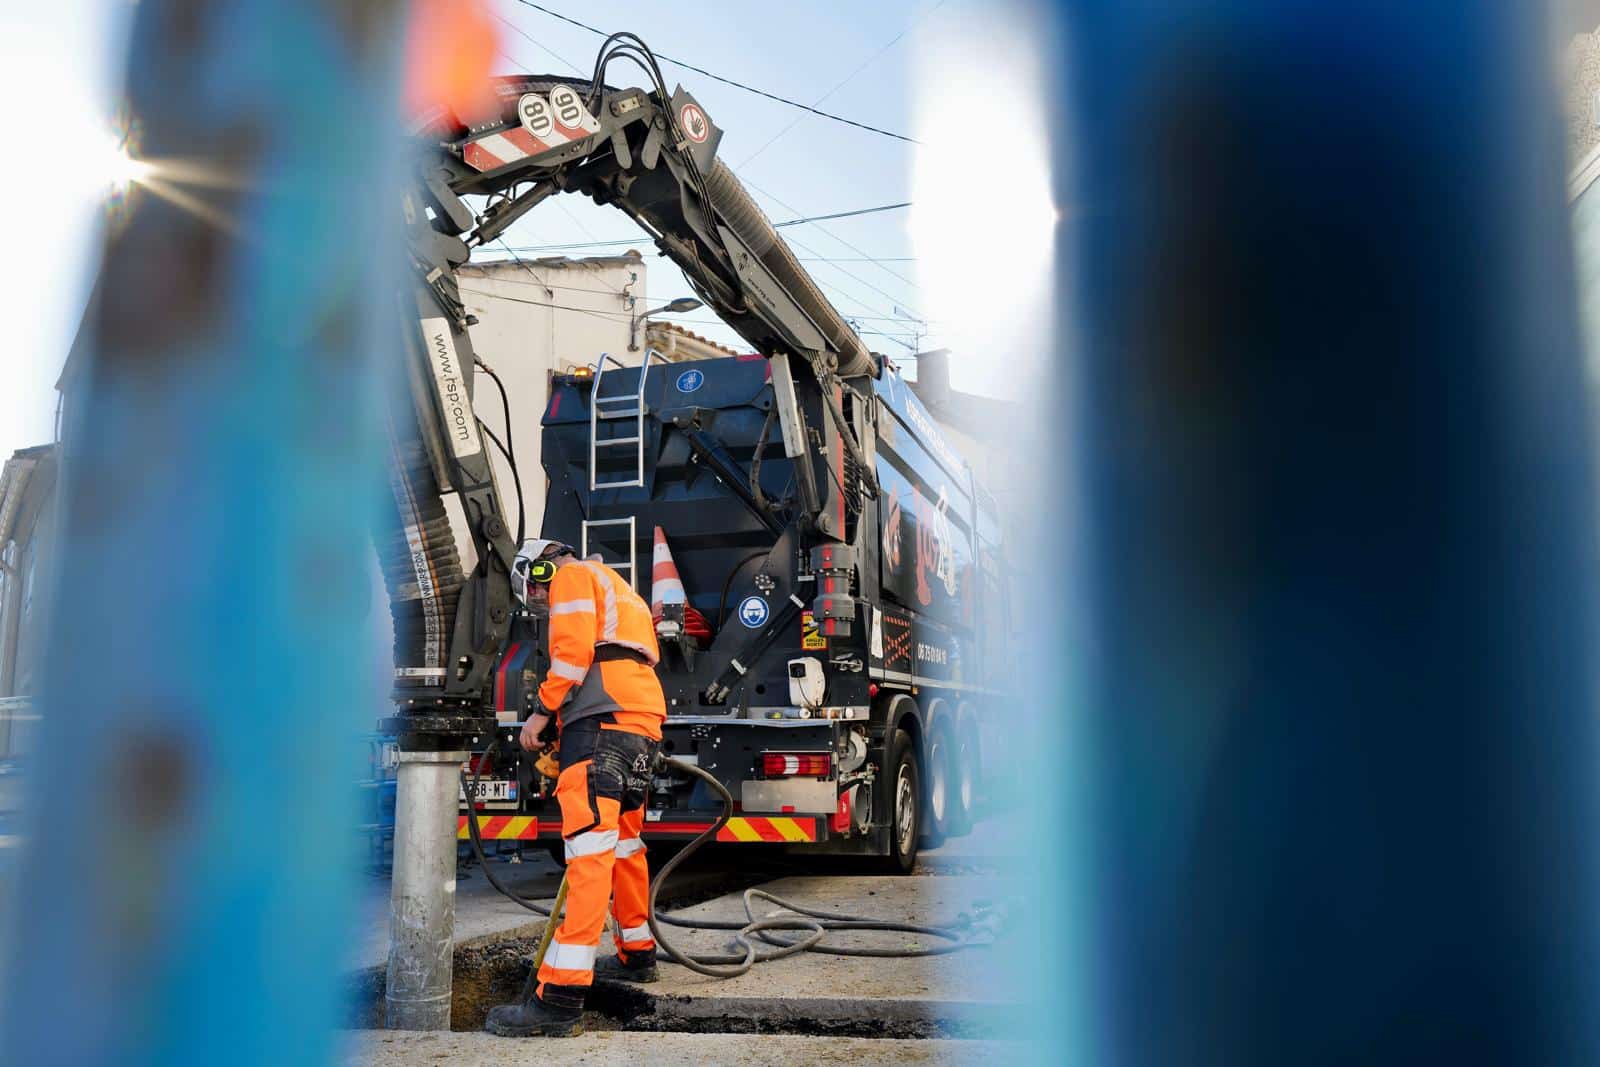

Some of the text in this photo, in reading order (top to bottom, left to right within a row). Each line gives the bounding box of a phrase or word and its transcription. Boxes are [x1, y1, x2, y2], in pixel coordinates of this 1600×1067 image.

[524, 102, 550, 130] 80
[555, 93, 579, 121] 90
[434, 333, 469, 440] www.rsp.com
